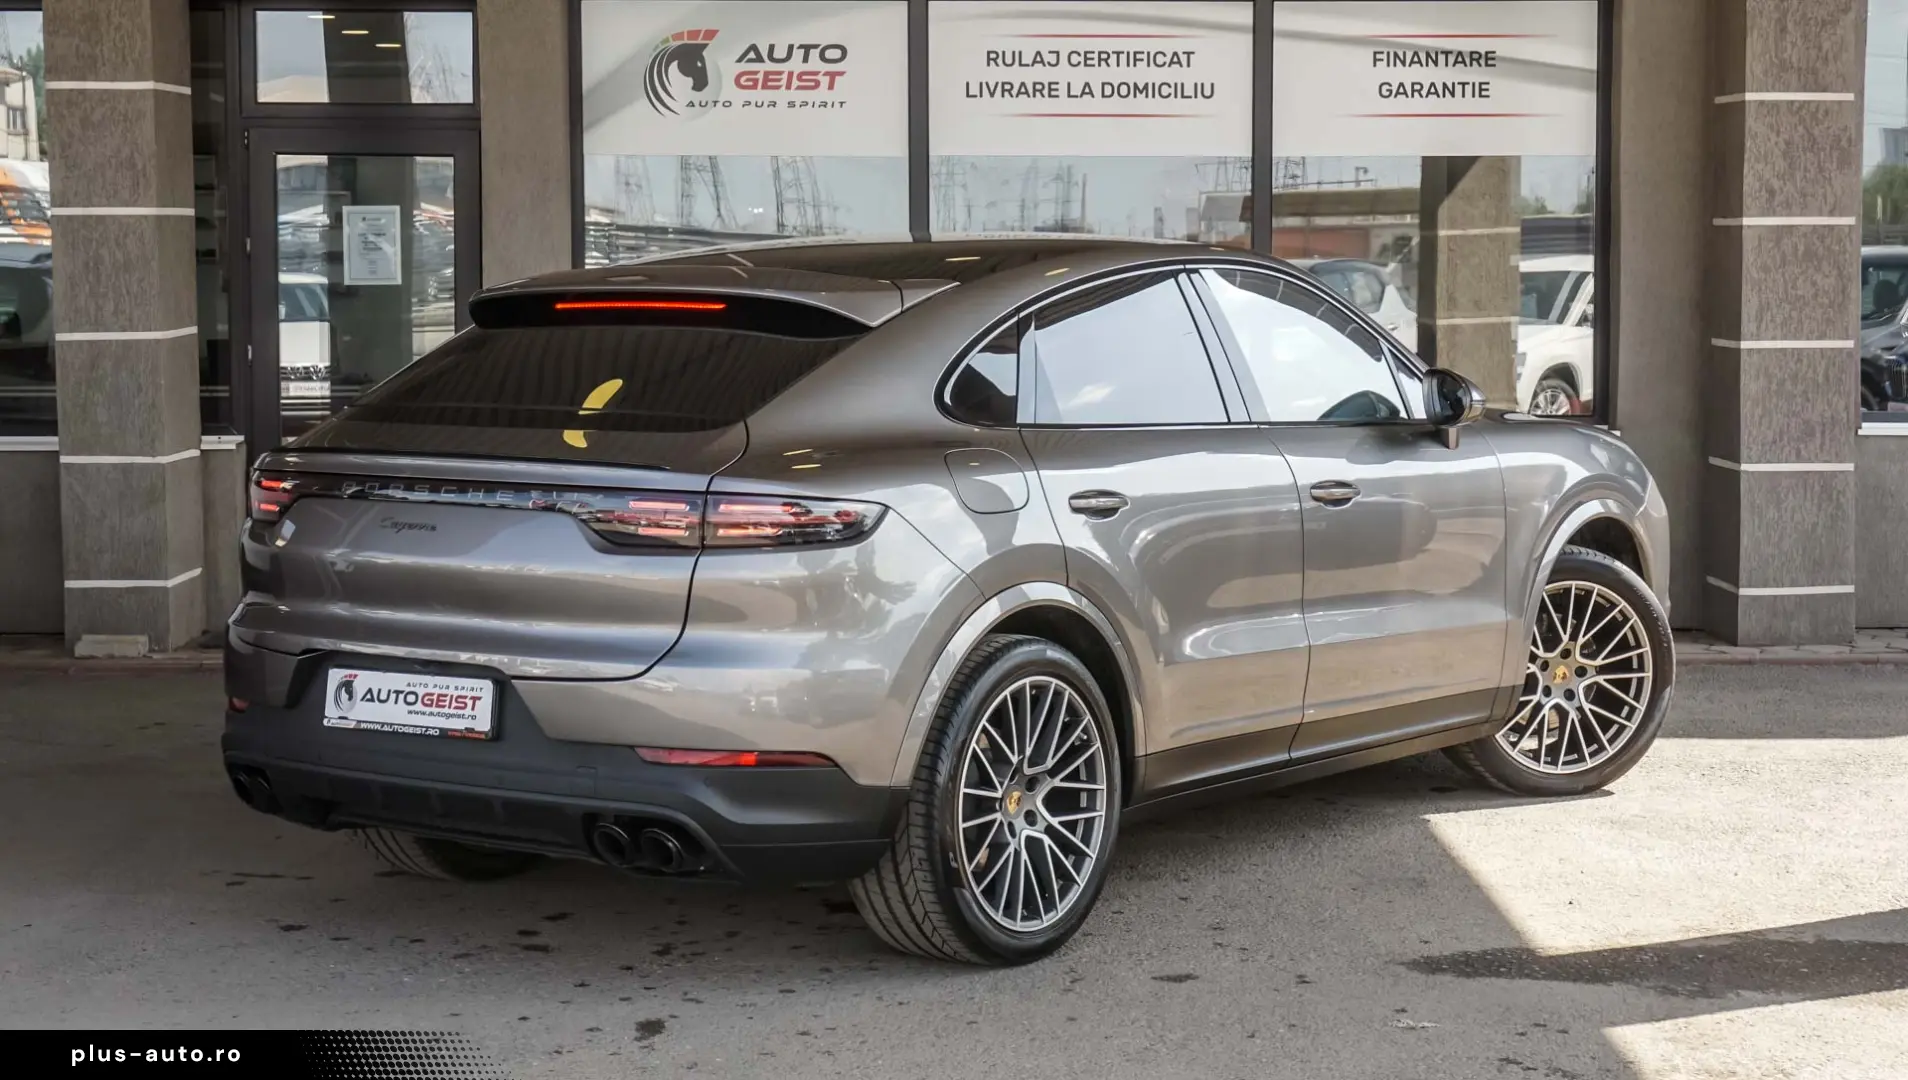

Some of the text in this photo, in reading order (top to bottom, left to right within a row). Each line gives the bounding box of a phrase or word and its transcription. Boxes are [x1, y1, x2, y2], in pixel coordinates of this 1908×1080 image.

[735, 43, 848, 64] AUTO
[986, 50, 1195, 68] RULAJ CERTIFICAT
[1372, 50, 1497, 68] FINANTARE
[734, 70, 847, 91] GEIST
[965, 81, 1215, 99] LIVRARE LA DOMICILIU
[1378, 81, 1491, 99] GARANTIE
[685, 100, 848, 108] AUTO PUR SPIRIT
[405, 681, 429, 689] AUTO
[453, 685, 485, 693] SPIRIT
[406, 708, 477, 721] www.autogeist.ro
[359, 721, 440, 736] WWW.AUTOGEIST.RO
